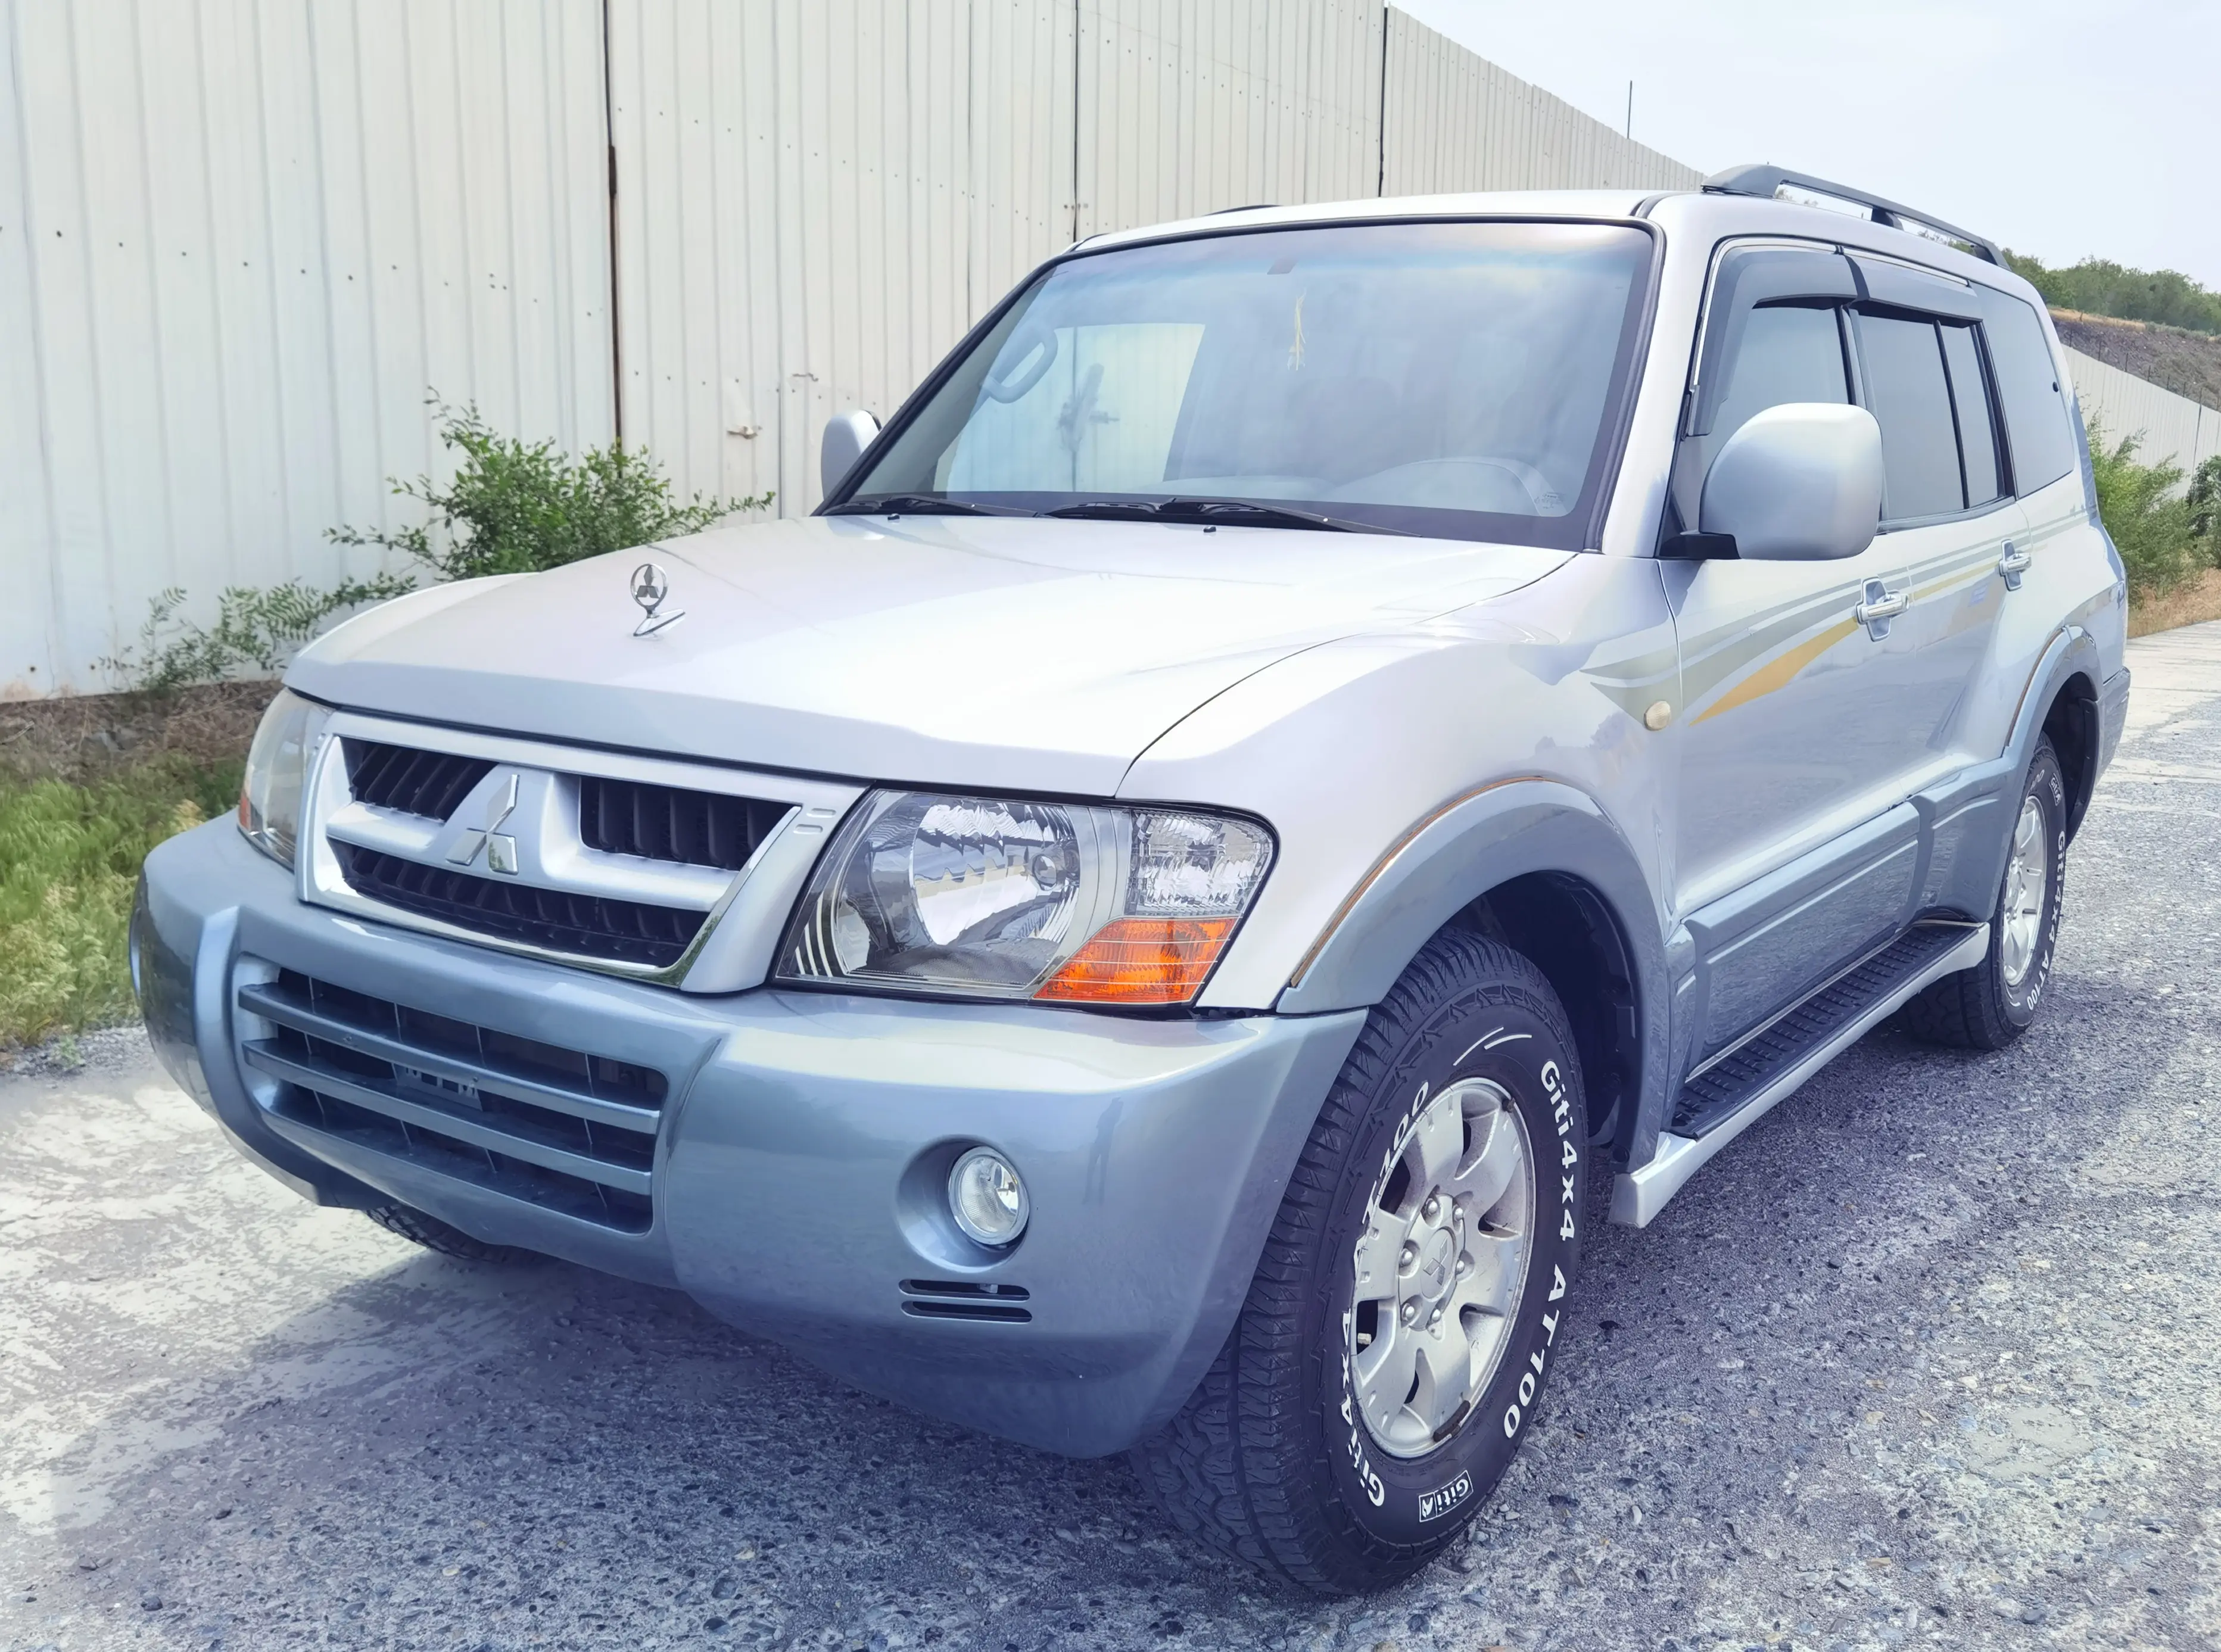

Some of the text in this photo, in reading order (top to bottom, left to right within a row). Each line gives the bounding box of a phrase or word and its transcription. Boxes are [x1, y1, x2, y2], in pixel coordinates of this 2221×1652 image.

[2027, 949, 2049, 1011] AT100
[1503, 1263, 1566, 1439] AT100
[1437, 1478, 1470, 1511] Giti
